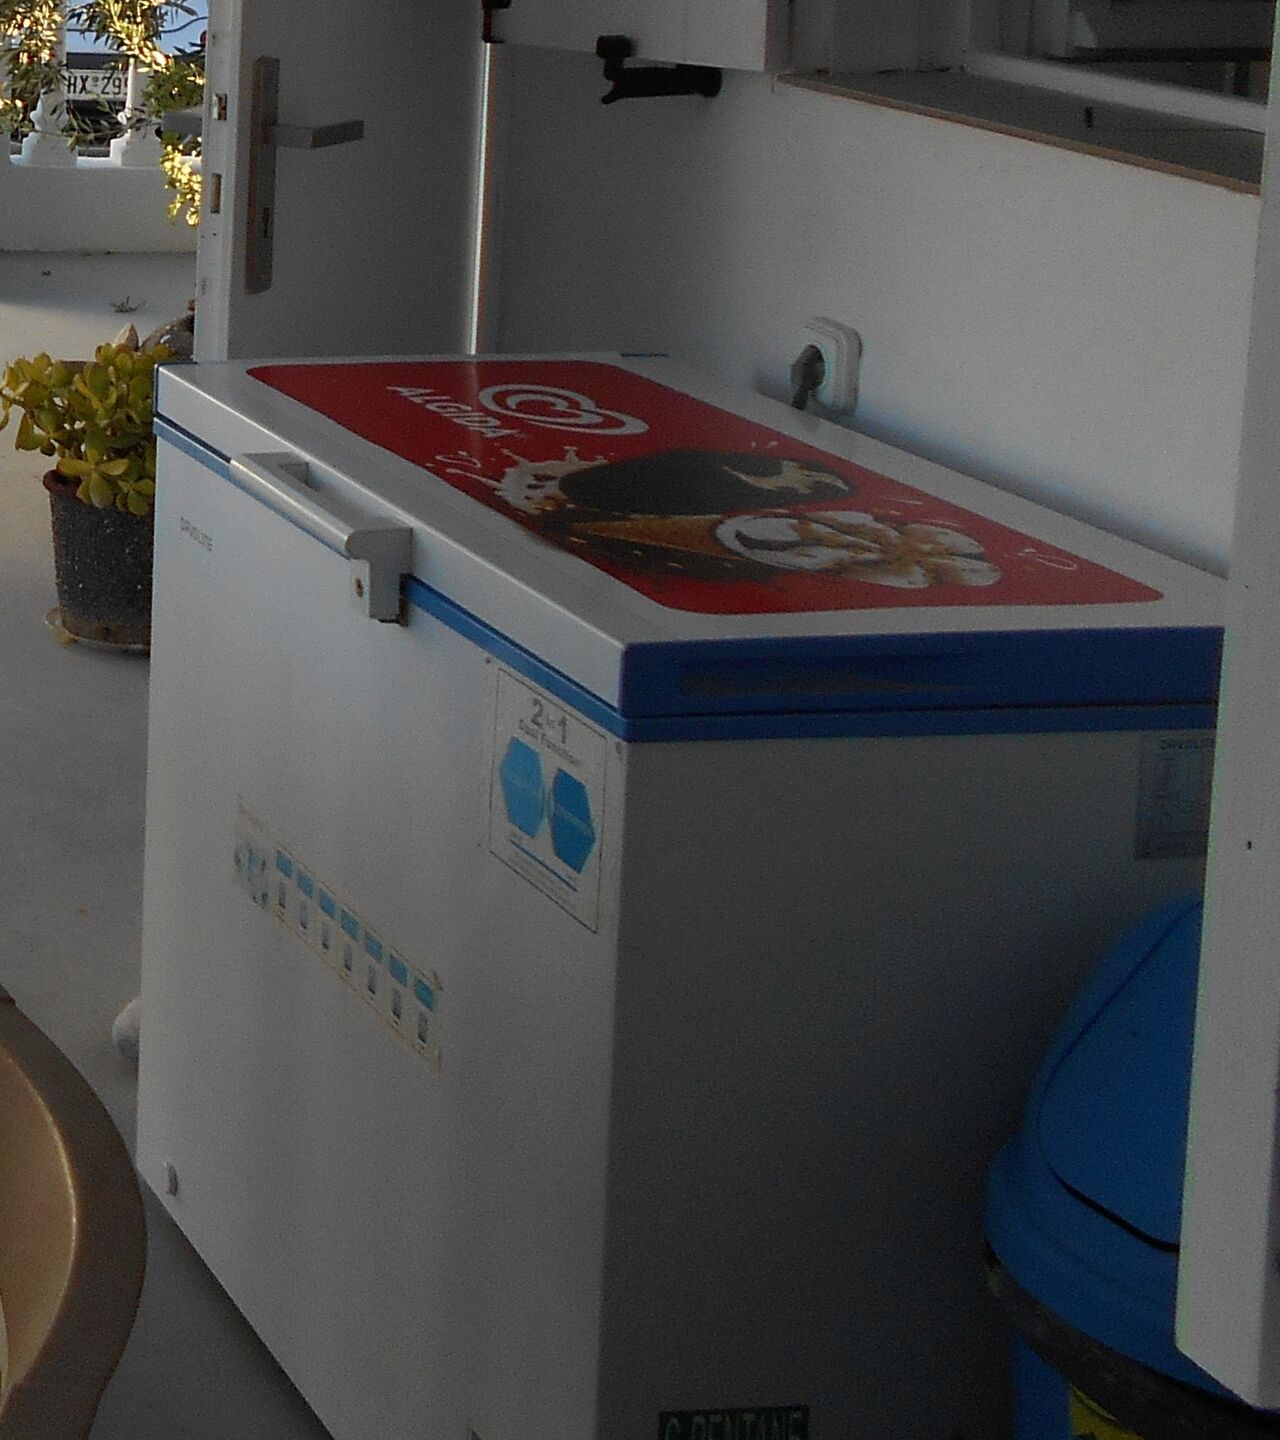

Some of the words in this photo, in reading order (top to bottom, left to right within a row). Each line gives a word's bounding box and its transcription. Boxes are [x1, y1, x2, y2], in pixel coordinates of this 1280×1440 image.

[385, 386, 521, 438] ALGIDA
[530, 698, 544, 729] 2
[558, 716, 567, 745] 1
